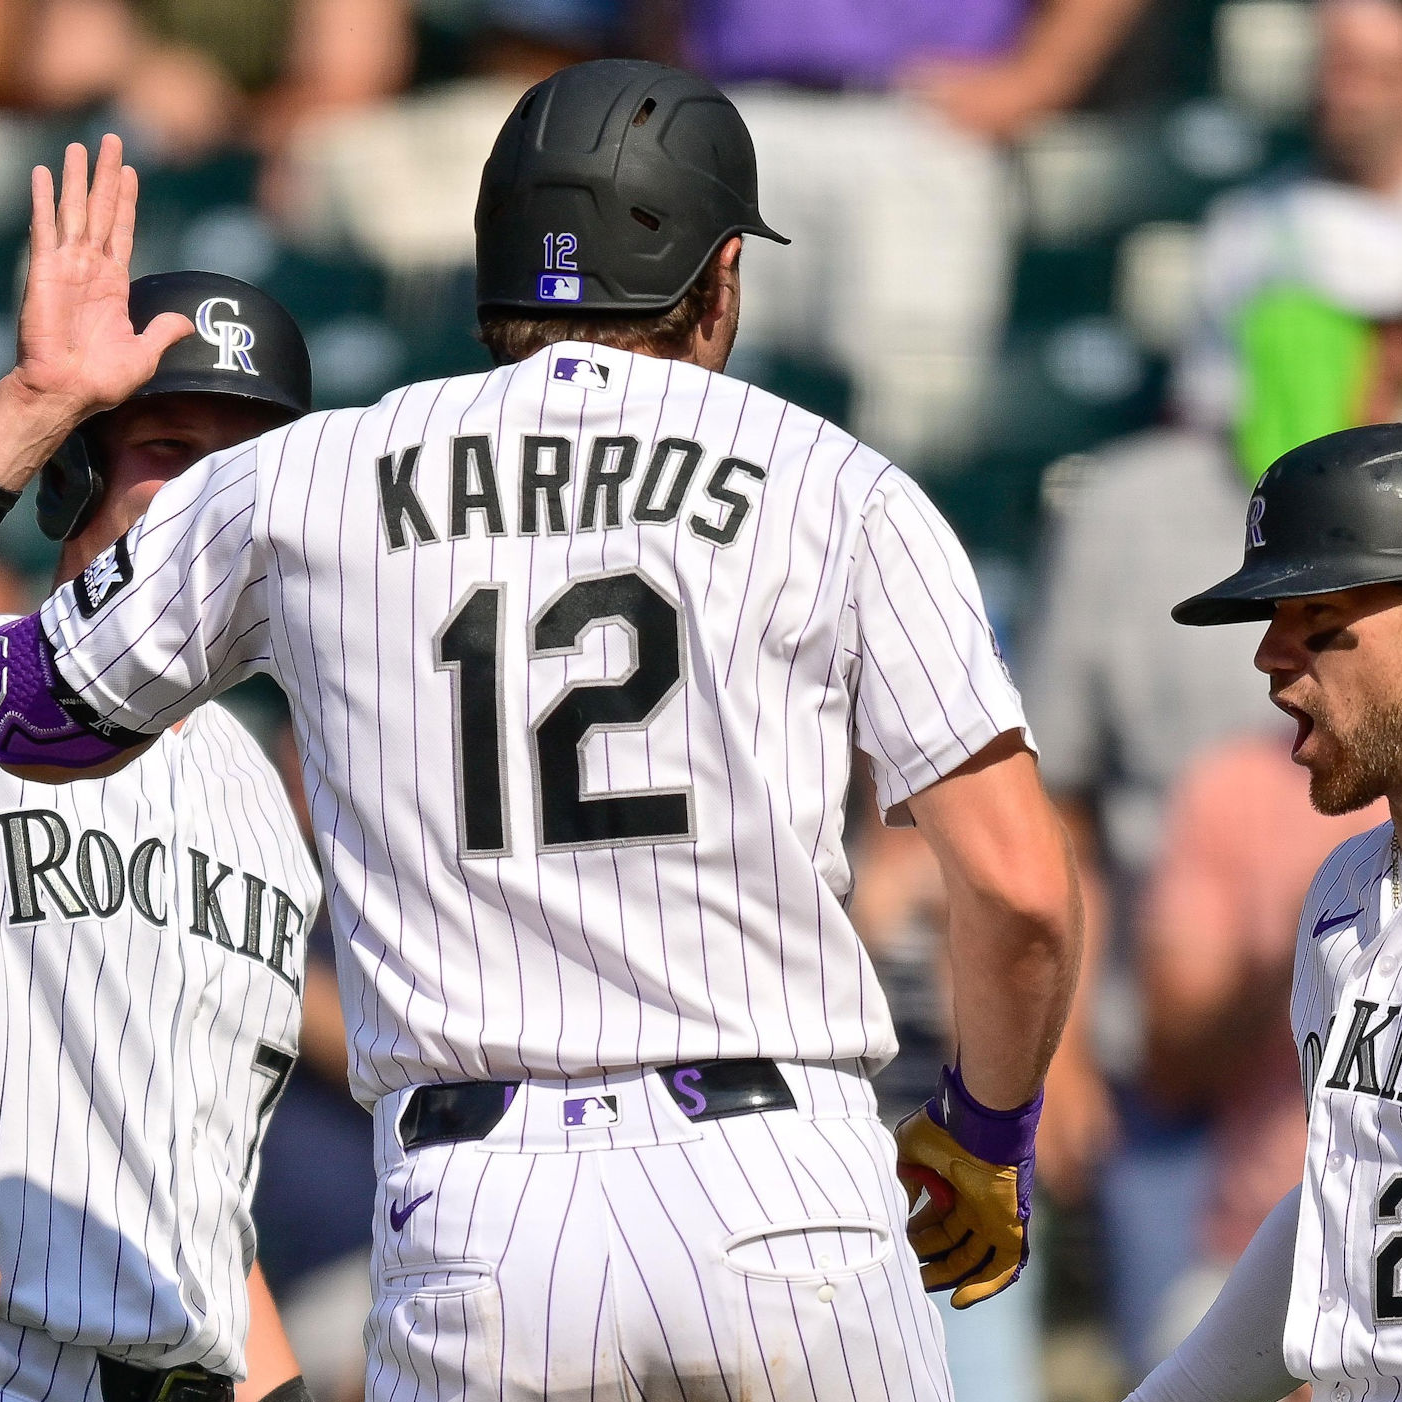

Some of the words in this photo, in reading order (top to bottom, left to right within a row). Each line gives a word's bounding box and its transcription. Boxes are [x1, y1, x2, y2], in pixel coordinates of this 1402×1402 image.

[543, 232, 579, 271] 12
[195, 297, 259, 377] CR
[375, 432, 768, 554] KARROS
[431, 564, 698, 861] 12
